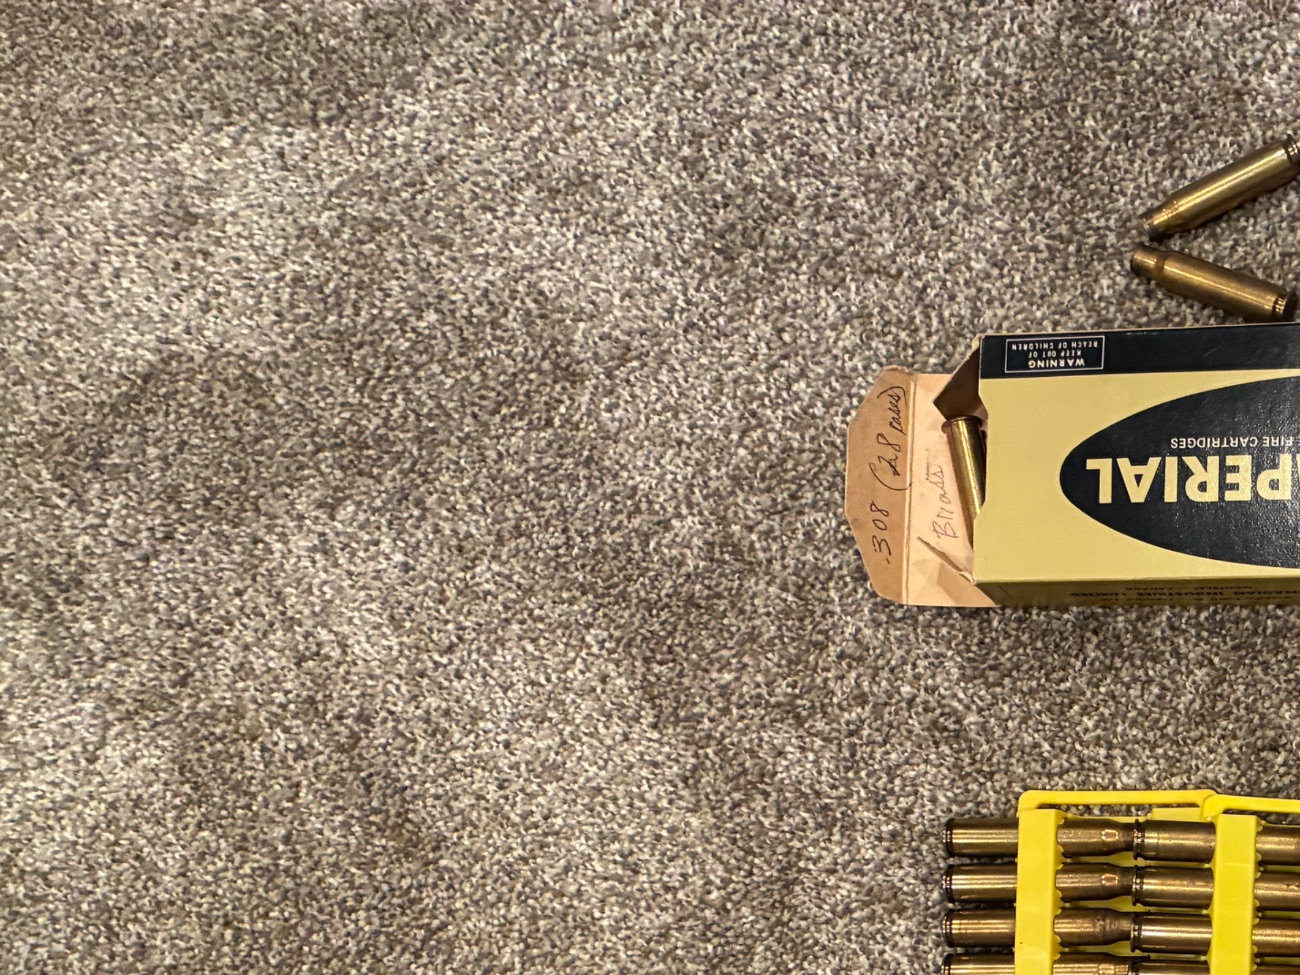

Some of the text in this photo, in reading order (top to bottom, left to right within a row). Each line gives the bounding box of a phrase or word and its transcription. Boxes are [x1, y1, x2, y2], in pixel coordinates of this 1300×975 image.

[1011, 340, 1098, 351] REACH OF CHILDREN
[1028, 349, 1082, 359] KEEP OUT OF
[1027, 357, 1085, 369] WARNING
[1169, 436, 1258, 449] CARTRIDGES
[1262, 435, 1294, 447] FIRE
[926, 463, 959, 539] Brass
